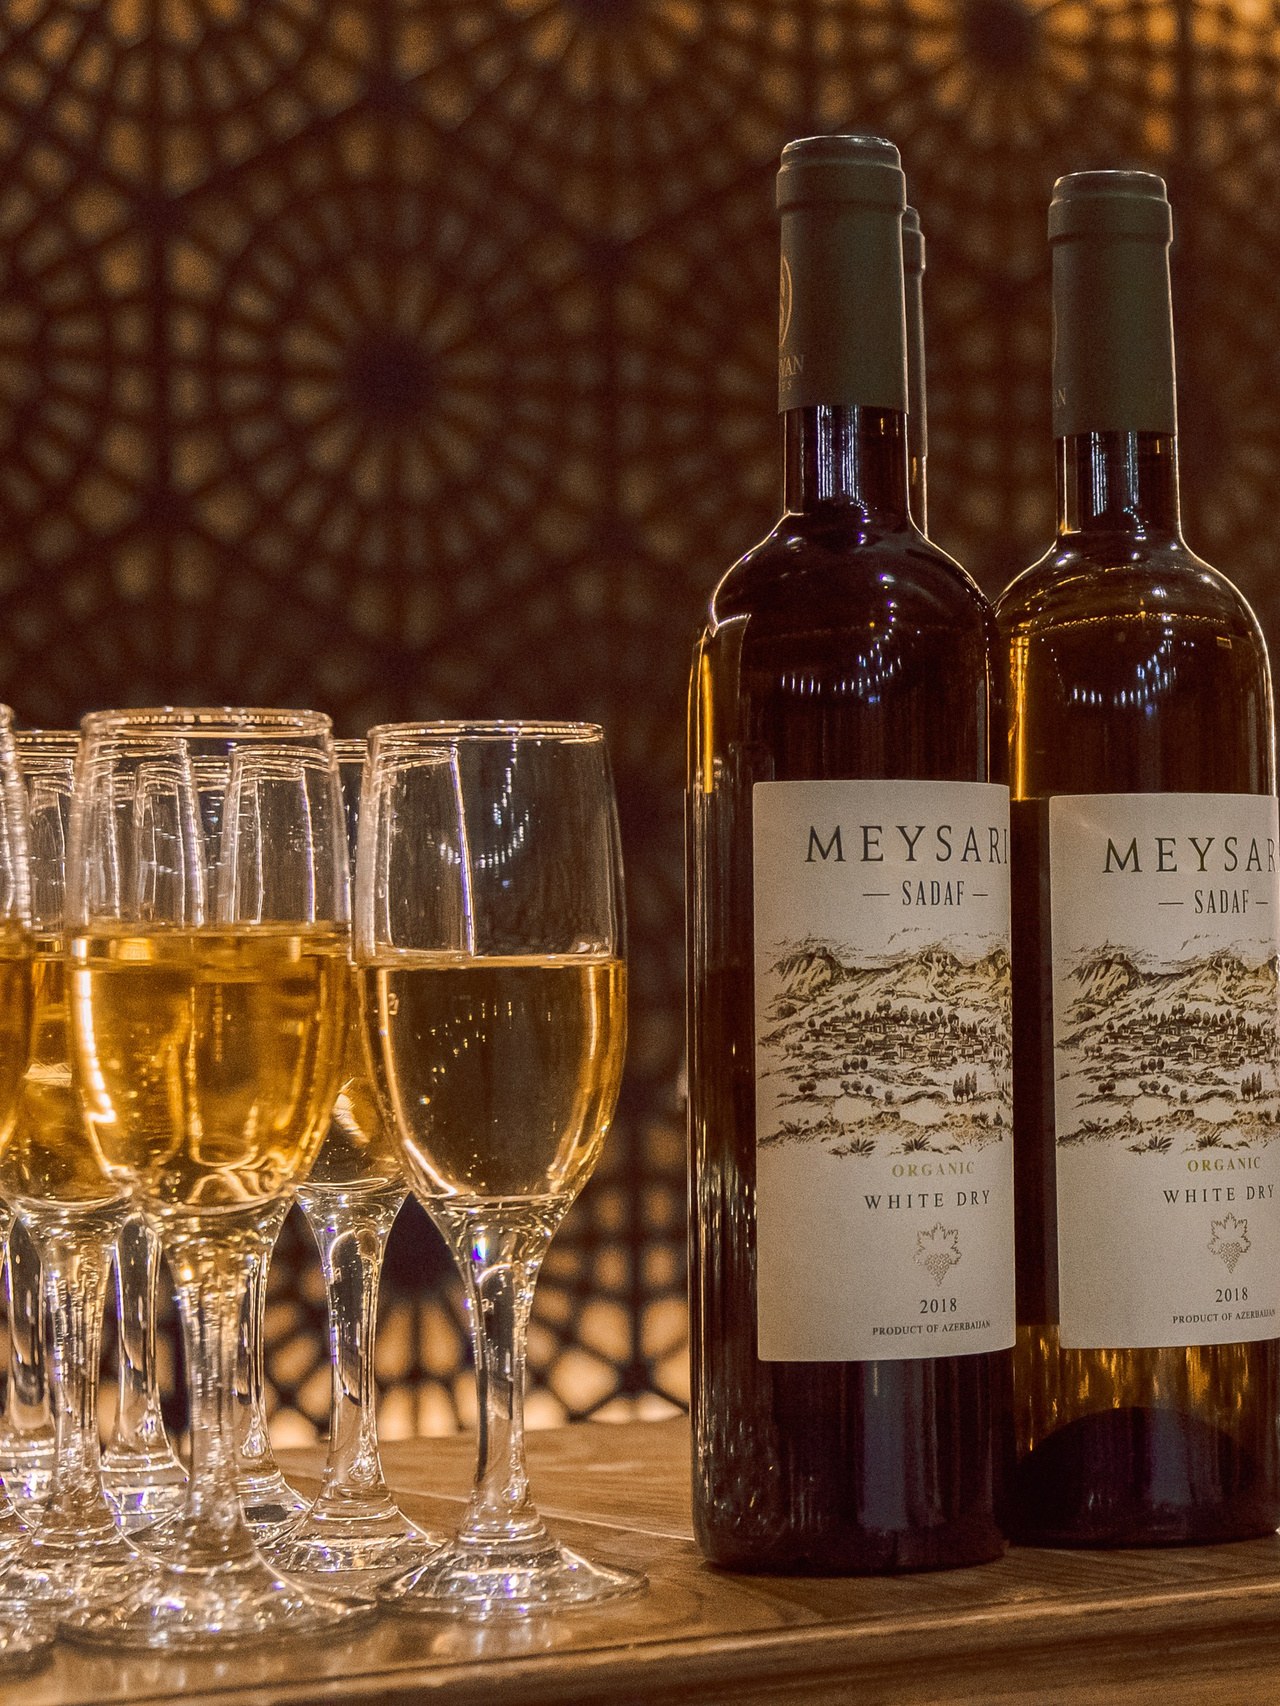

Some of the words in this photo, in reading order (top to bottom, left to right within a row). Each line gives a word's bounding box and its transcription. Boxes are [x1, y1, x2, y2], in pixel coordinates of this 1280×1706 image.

[804, 823, 1008, 865] MEYSARI
[1102, 835, 1278, 873] MEYSAR
[901, 880, 965, 907] SADAF
[1193, 889, 1250, 914] SADAF
[891, 1161, 975, 1177] ORGANIC
[1187, 1156, 1261, 1172] ORGANIC
[863, 1192, 944, 1210] WHITE
[957, 1189, 990, 1206] DRY
[1162, 1187, 1236, 1204] WHITE
[1246, 1184, 1274, 1201] DRY
[1215, 1286, 1249, 1303] 2018
[919, 1297, 958, 1314] 2018
[1172, 1313, 1219, 1324] PRODUCT
[1221, 1312, 1233, 1321] OF
[872, 1325, 924, 1336] PRODUCT
[926, 1324, 939, 1333] OF
[941, 1319, 991, 1332] AZERBAIJAN
